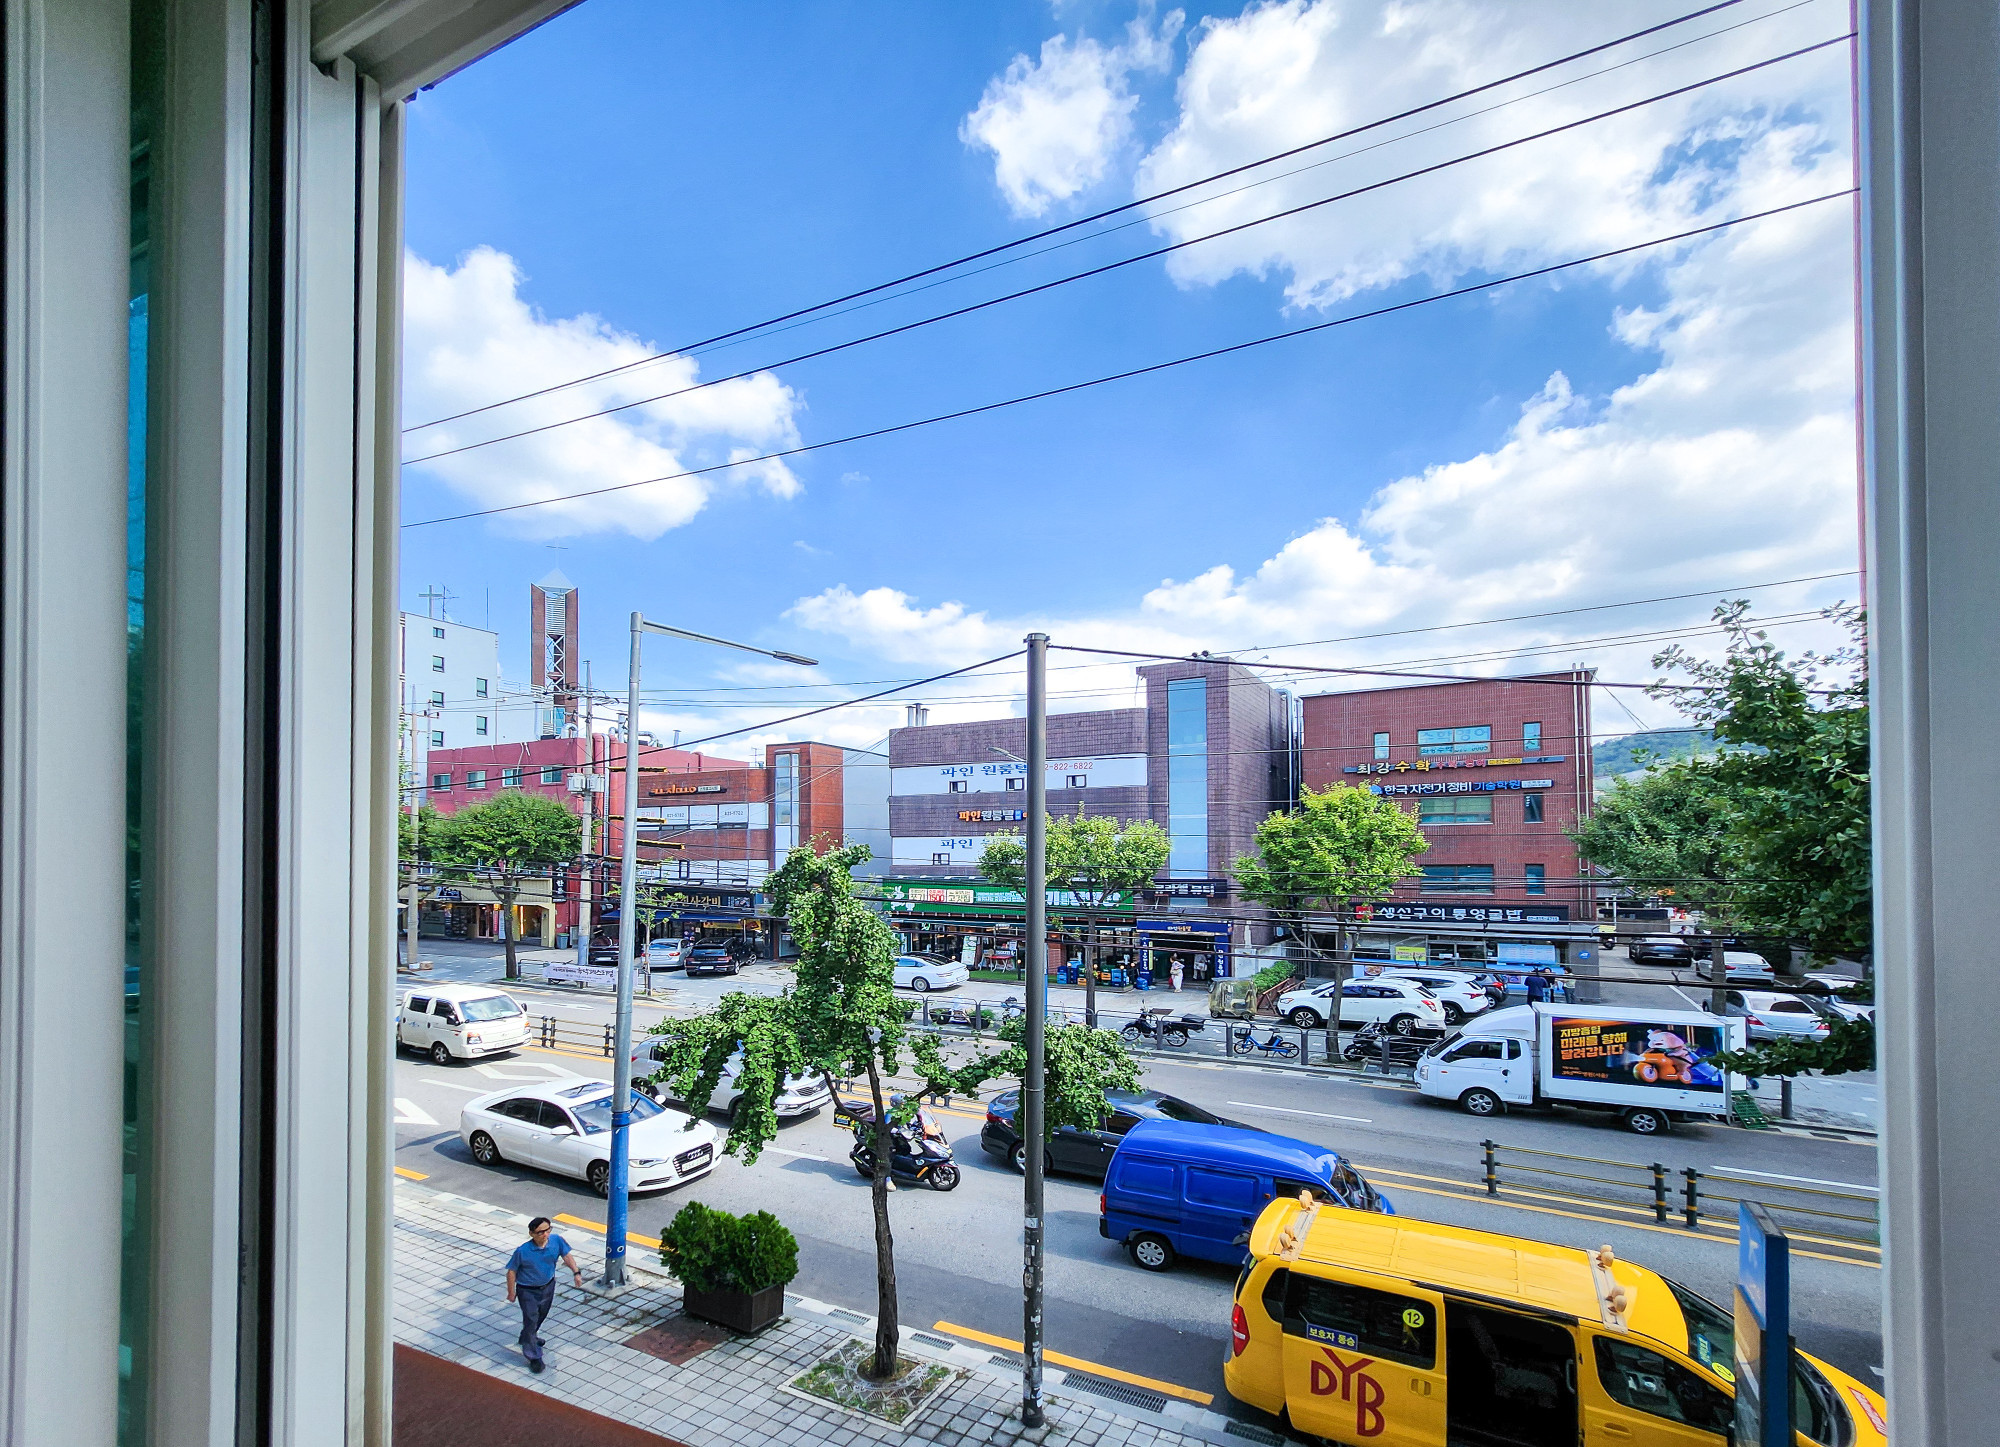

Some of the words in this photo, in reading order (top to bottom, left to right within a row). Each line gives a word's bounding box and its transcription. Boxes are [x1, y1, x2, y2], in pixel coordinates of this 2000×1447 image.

[941, 767, 974, 777] 파인
[1384, 784, 1409, 796] 한국
[1410, 782, 1446, 795] 자전거
[1447, 781, 1473, 793] 정비
[941, 838, 973, 849] 파인
[1379, 907, 1446, 920] 생선구이
[1561, 1026, 1600, 1037] 지방흡입
[1560, 1036, 1598, 1048] 미래를
[1602, 1032, 1628, 1044] 향해
[1561, 1044, 1624, 1059] 달려갑니다
[1407, 1311, 1421, 1325] 12
[1309, 1328, 1335, 1341] 보호자
[1338, 1334, 1356, 1346] 동승
[1310, 1346, 1385, 1437] DYB
